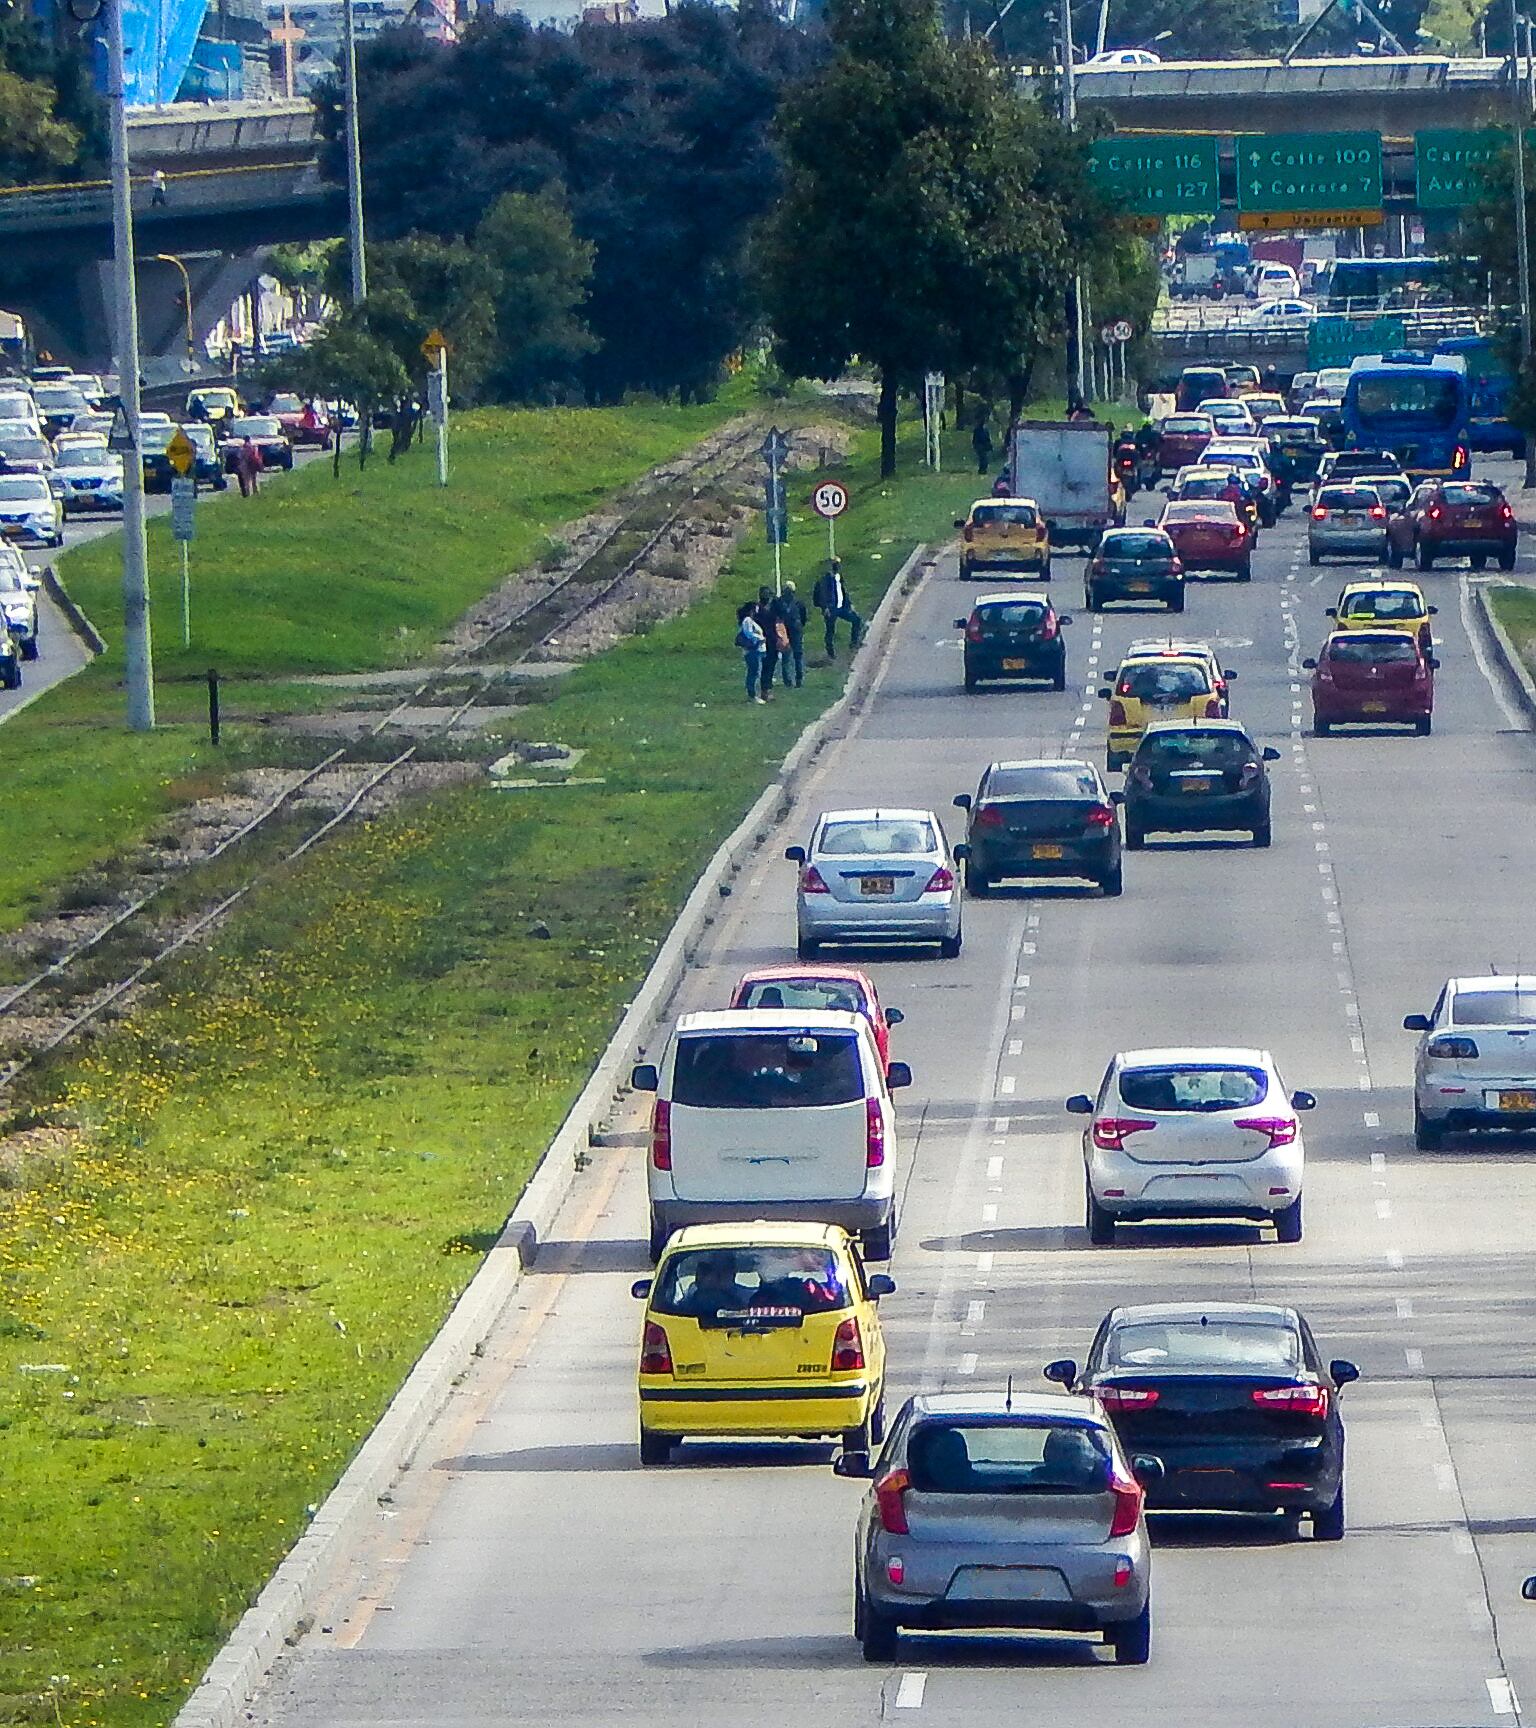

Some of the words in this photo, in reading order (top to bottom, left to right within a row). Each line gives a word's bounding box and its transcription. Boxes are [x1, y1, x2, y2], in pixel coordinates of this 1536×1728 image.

[1175, 154, 1202, 169] 116
[1271, 150, 1325, 166] Calle
[1336, 149, 1371, 164] 100
[1176, 181, 1209, 198] 127
[1359, 177, 1371, 192] 7
[820, 490, 843, 508] 50
